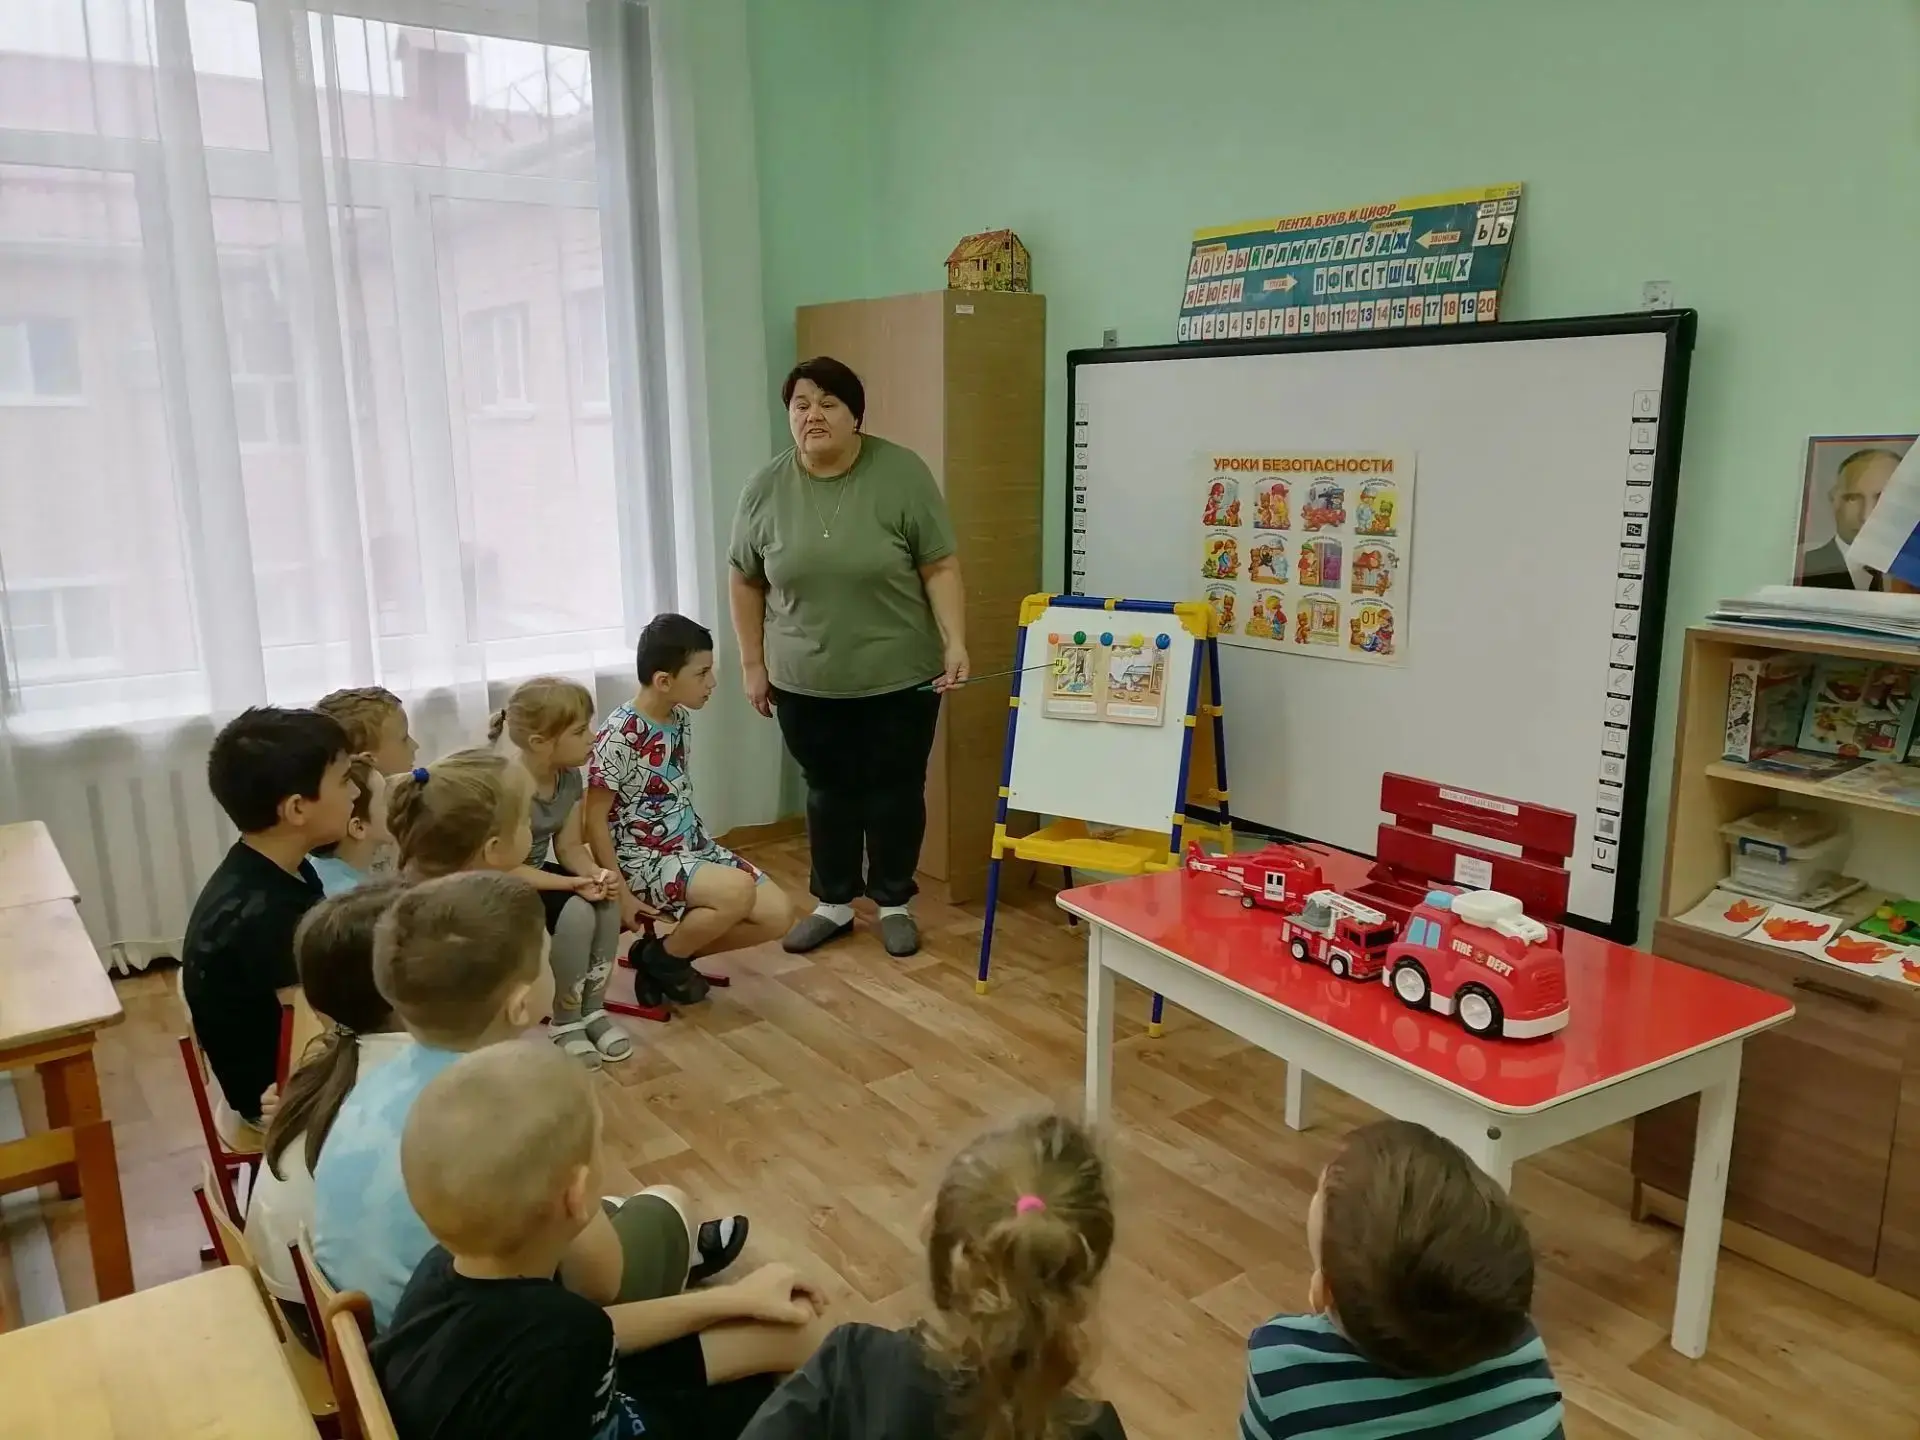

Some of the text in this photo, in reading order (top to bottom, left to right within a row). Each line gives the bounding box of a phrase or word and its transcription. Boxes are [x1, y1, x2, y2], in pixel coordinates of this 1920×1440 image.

[1276, 216, 1312, 231] ЛЕНТА
[1316, 210, 1346, 225] БУКВ
[1360, 204, 1397, 222] ЦИФР
[1181, 296, 1494, 335] 0 1 2 3 4 5 6 7 8 9 10 11 12 13 14 15 16 17 18 19 20
[1213, 458, 1393, 472] УРОКИ БЕЗОПАСНОСТИ
[1362, 610, 1376, 624] 01
[1452, 939, 1514, 977] FIRE DEPT
